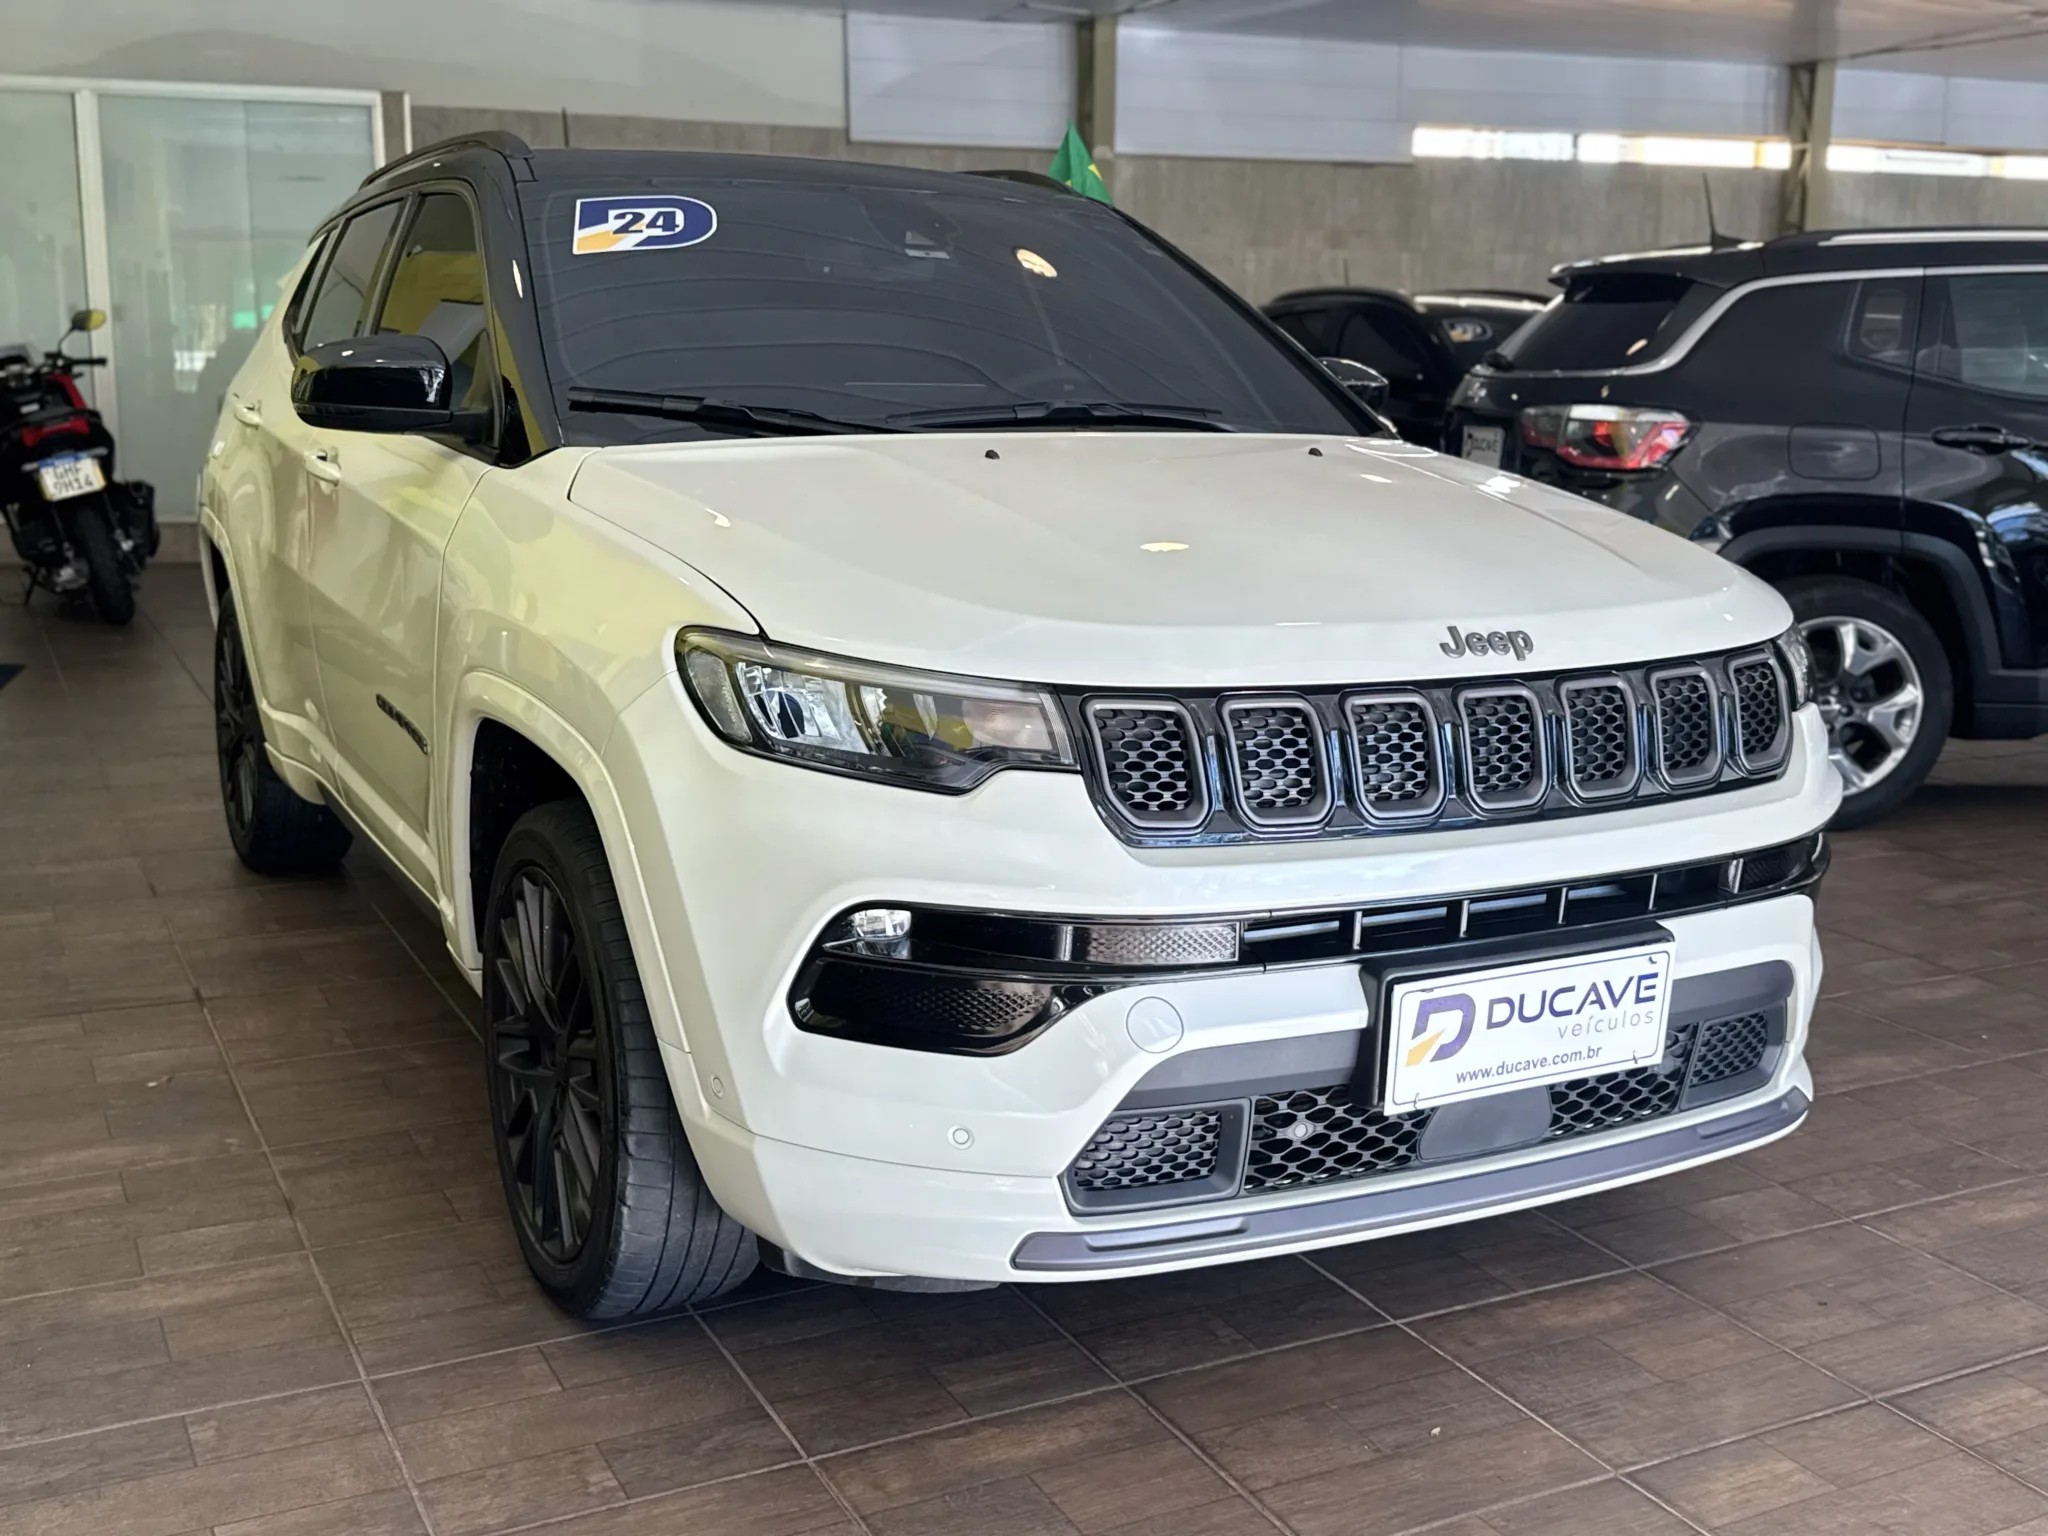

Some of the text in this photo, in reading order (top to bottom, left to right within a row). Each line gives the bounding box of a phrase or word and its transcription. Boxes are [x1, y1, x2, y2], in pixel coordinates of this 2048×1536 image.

[613, 210, 679, 235] 24
[1439, 625, 1534, 661] Jeep
[1486, 972, 1659, 1030] DUCAVE
[1557, 1010, 1655, 1039] veículos
[1456, 1046, 1602, 1084] www.ducave.com.br
